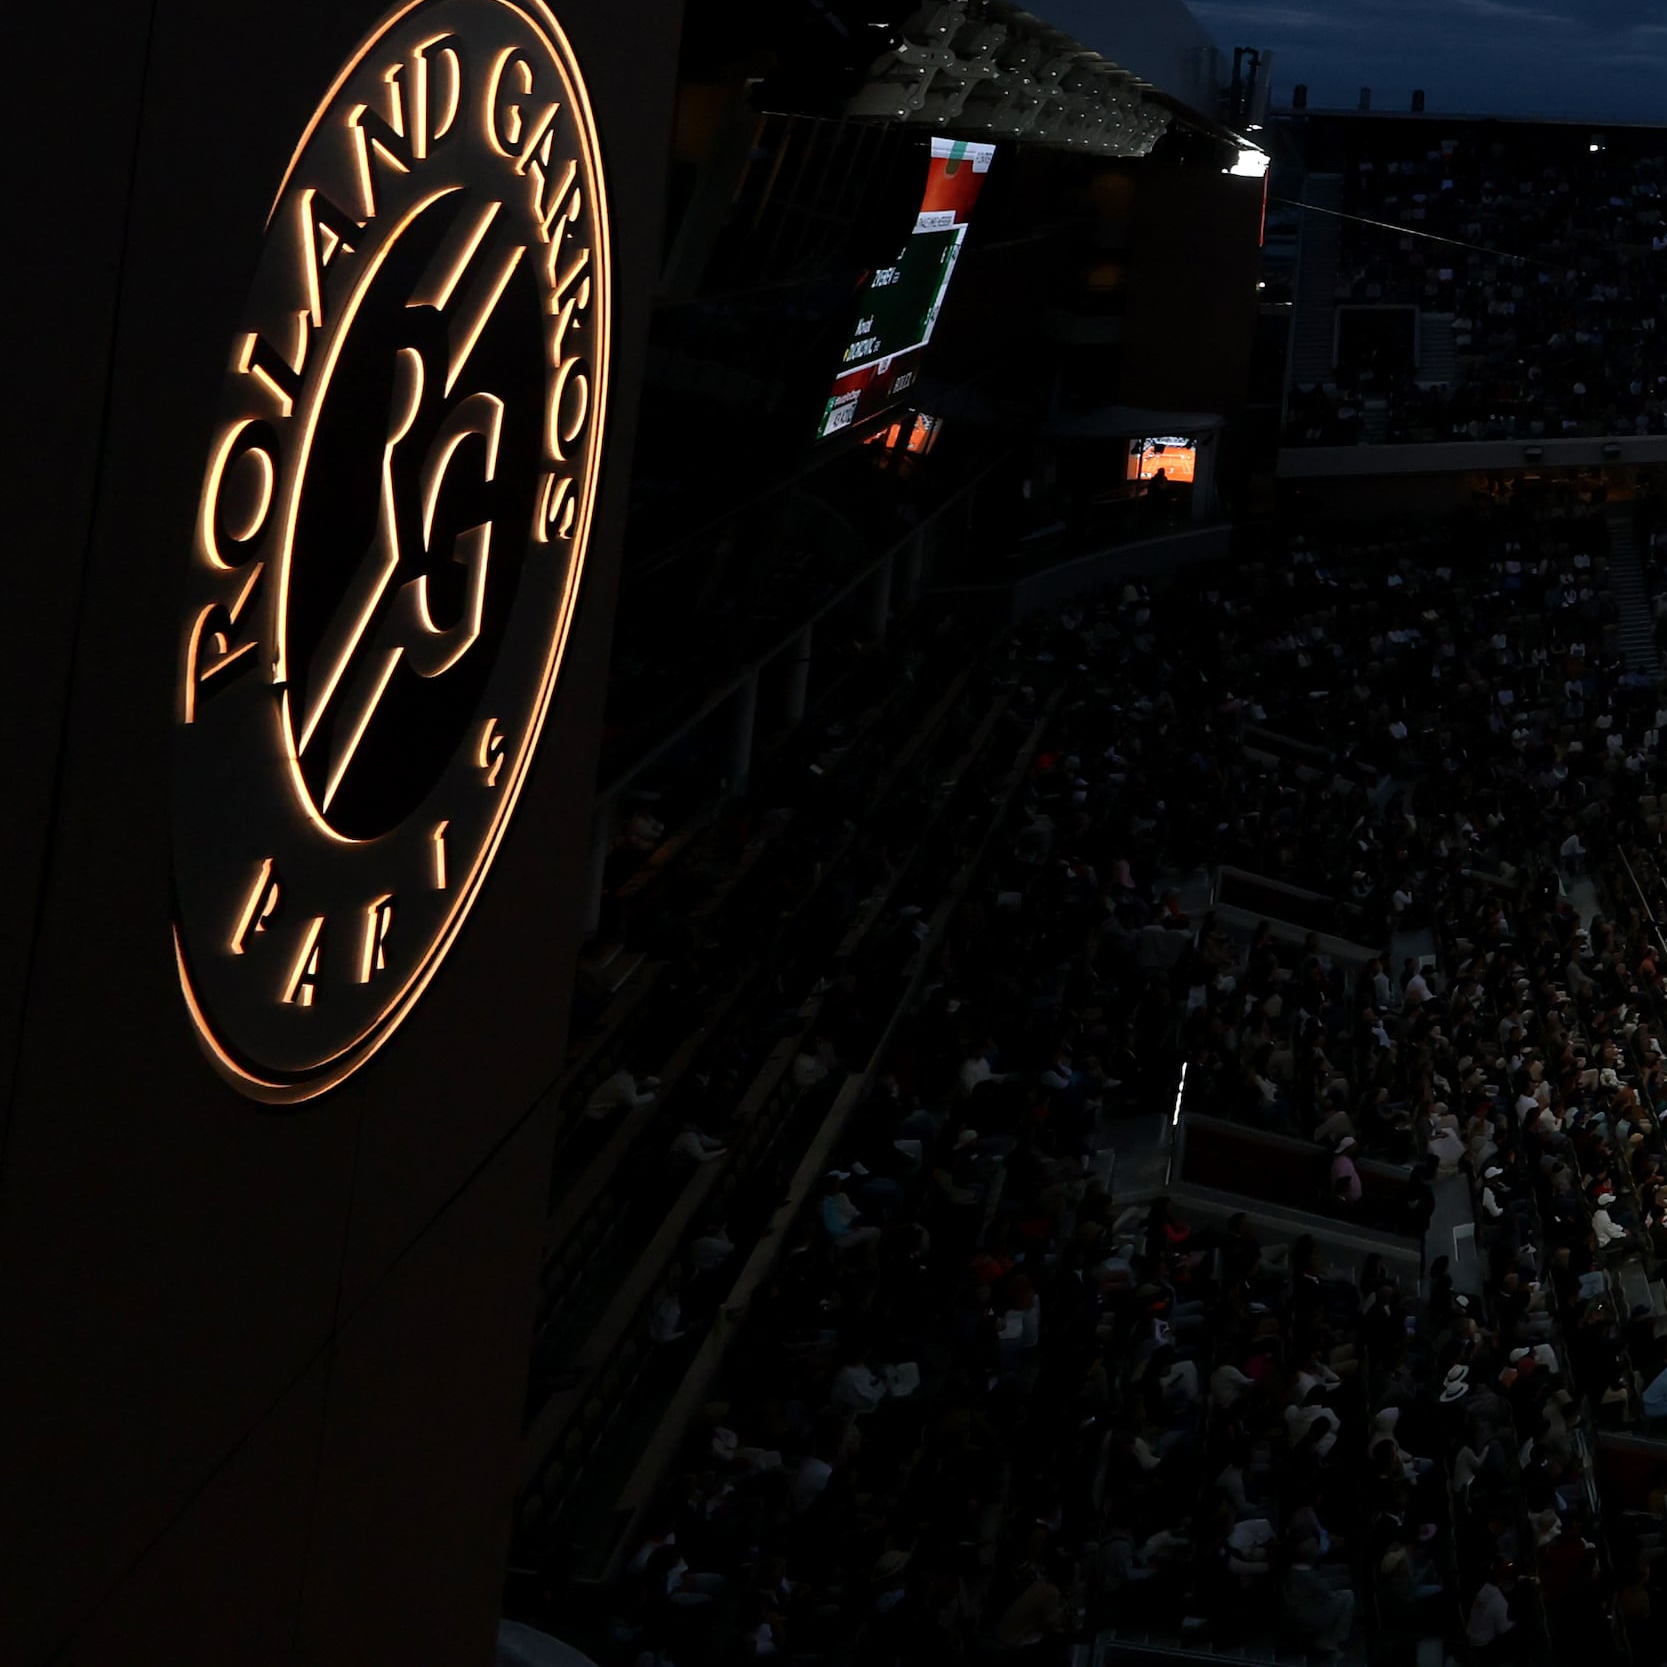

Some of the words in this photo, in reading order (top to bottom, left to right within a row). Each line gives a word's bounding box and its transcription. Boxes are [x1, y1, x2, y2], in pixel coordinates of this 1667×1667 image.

[185, 33, 461, 724] ROLAND
[488, 46, 592, 542] GARROS
[230, 719, 506, 1006] PARIS
